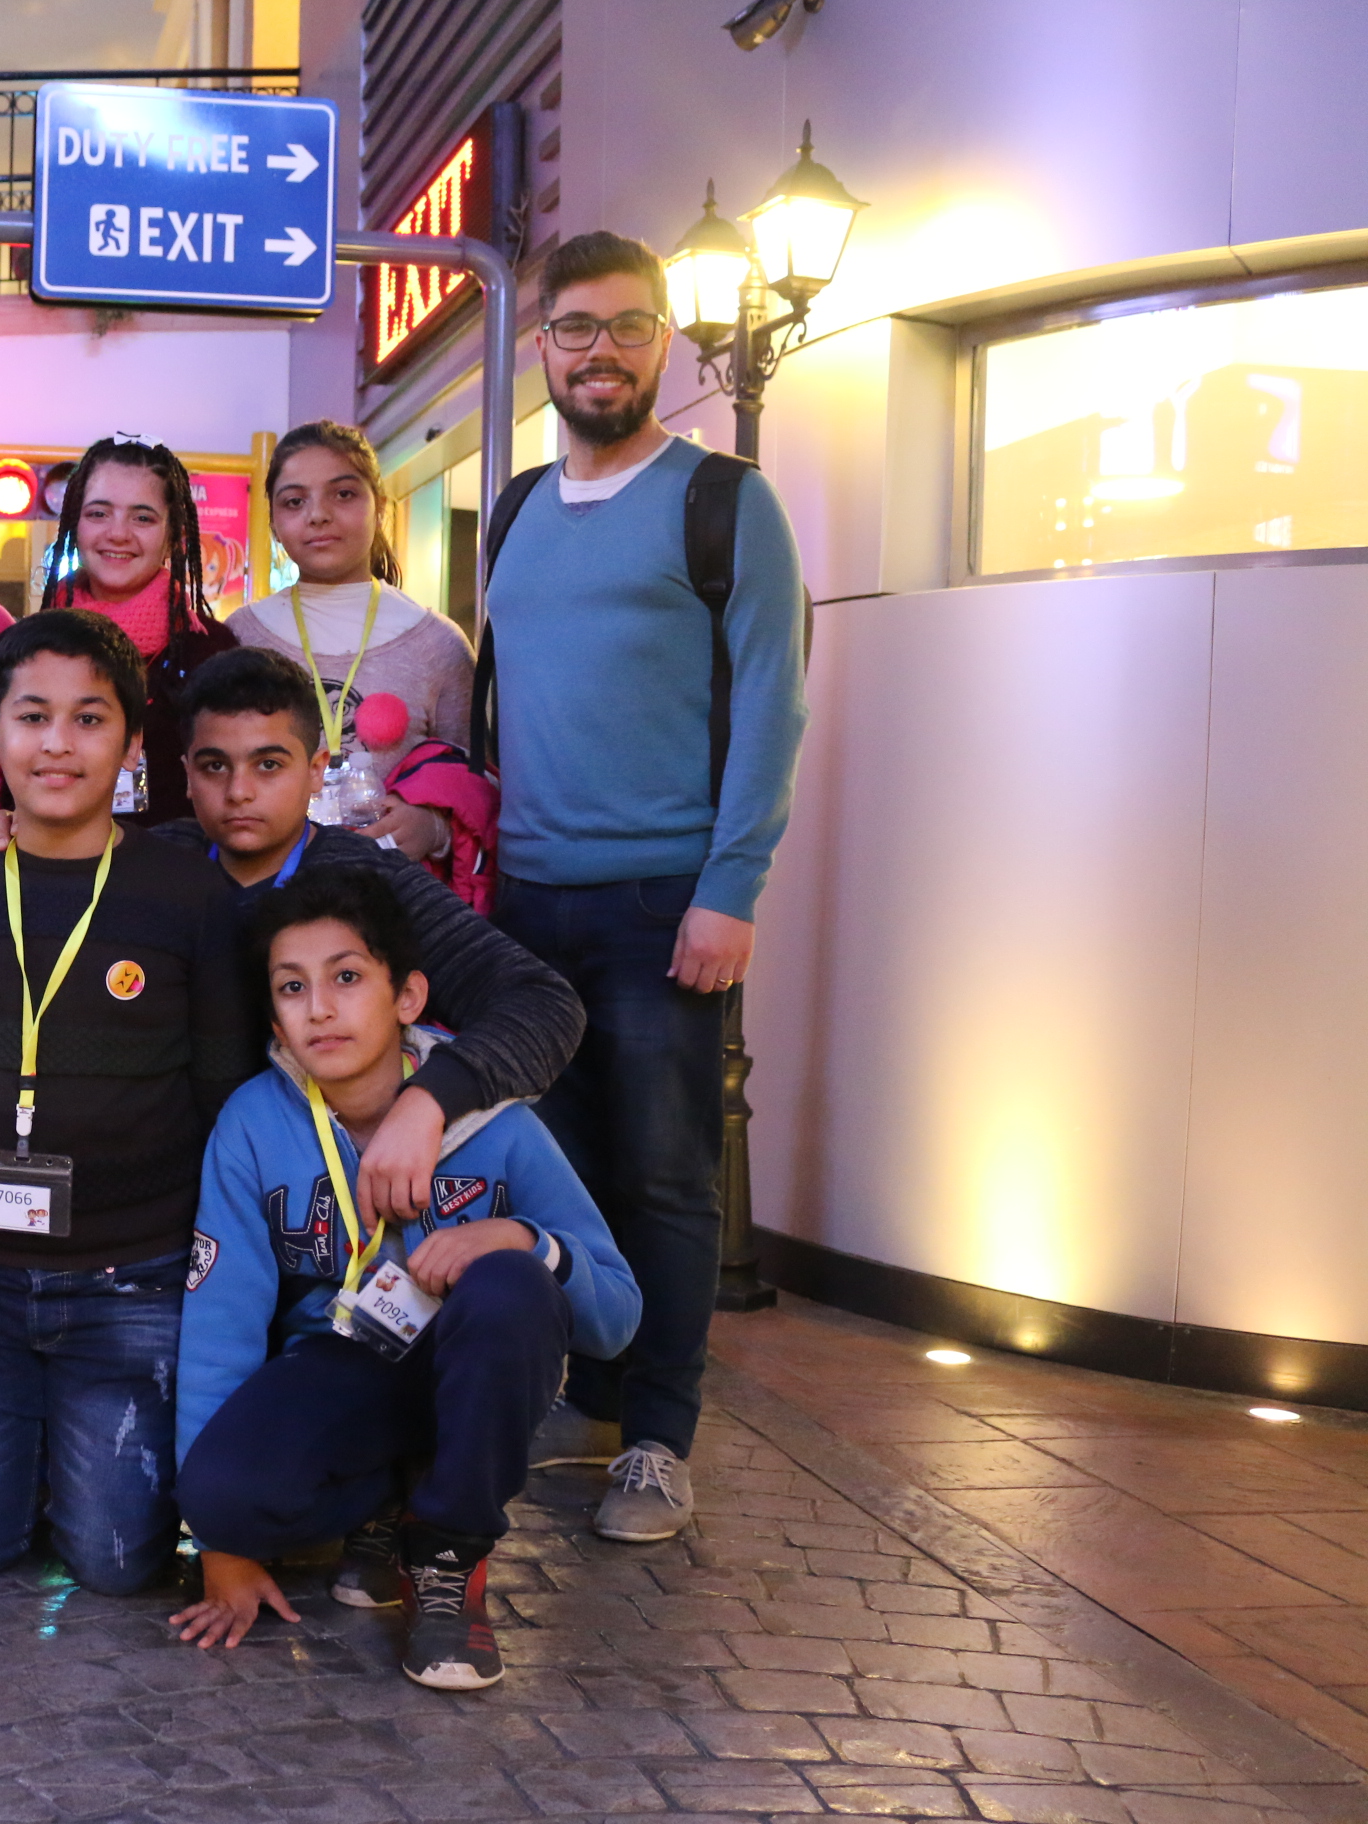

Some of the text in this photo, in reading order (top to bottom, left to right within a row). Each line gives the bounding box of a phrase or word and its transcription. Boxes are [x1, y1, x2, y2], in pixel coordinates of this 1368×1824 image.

[58, 126, 249, 174] DUTY FREE
[139, 206, 244, 263] EXIT
[438, 1180, 464, 1198] KTK
[442, 1194, 464, 1213] BEST
[373, 1295, 409, 1326] 2604
